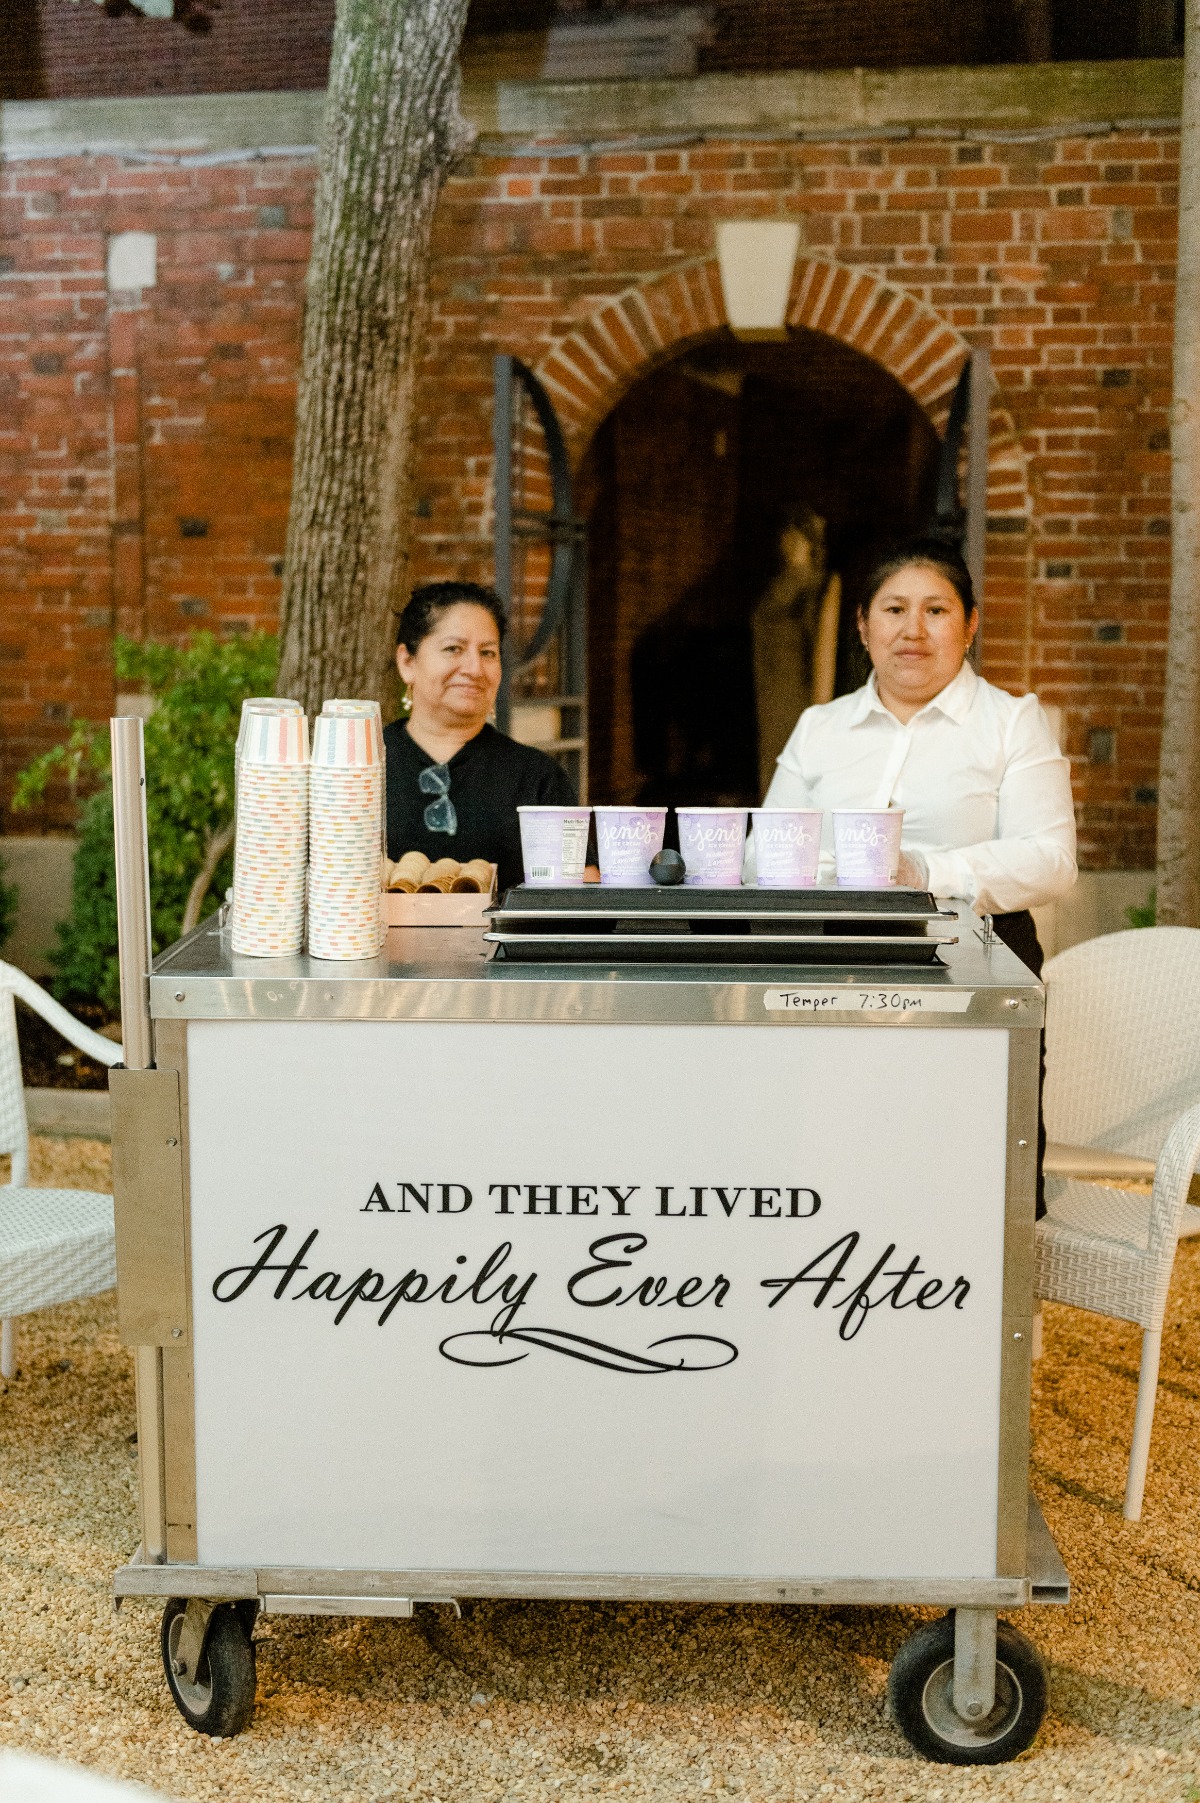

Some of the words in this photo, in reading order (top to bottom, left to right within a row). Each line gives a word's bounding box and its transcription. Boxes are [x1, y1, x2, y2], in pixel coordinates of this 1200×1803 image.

[599, 821, 659, 850] jeni's
[838, 823, 888, 848] eni's
[780, 992, 838, 1011] Temper
[859, 993, 922, 1010] 7:30pm
[361, 1184, 473, 1214] AND
[490, 1186, 641, 1216] THEY
[656, 1188, 822, 1218] LIVED
[213, 1225, 537, 1336] Happily
[568, 1234, 731, 1309] Ever
[761, 1232, 971, 1341] After
